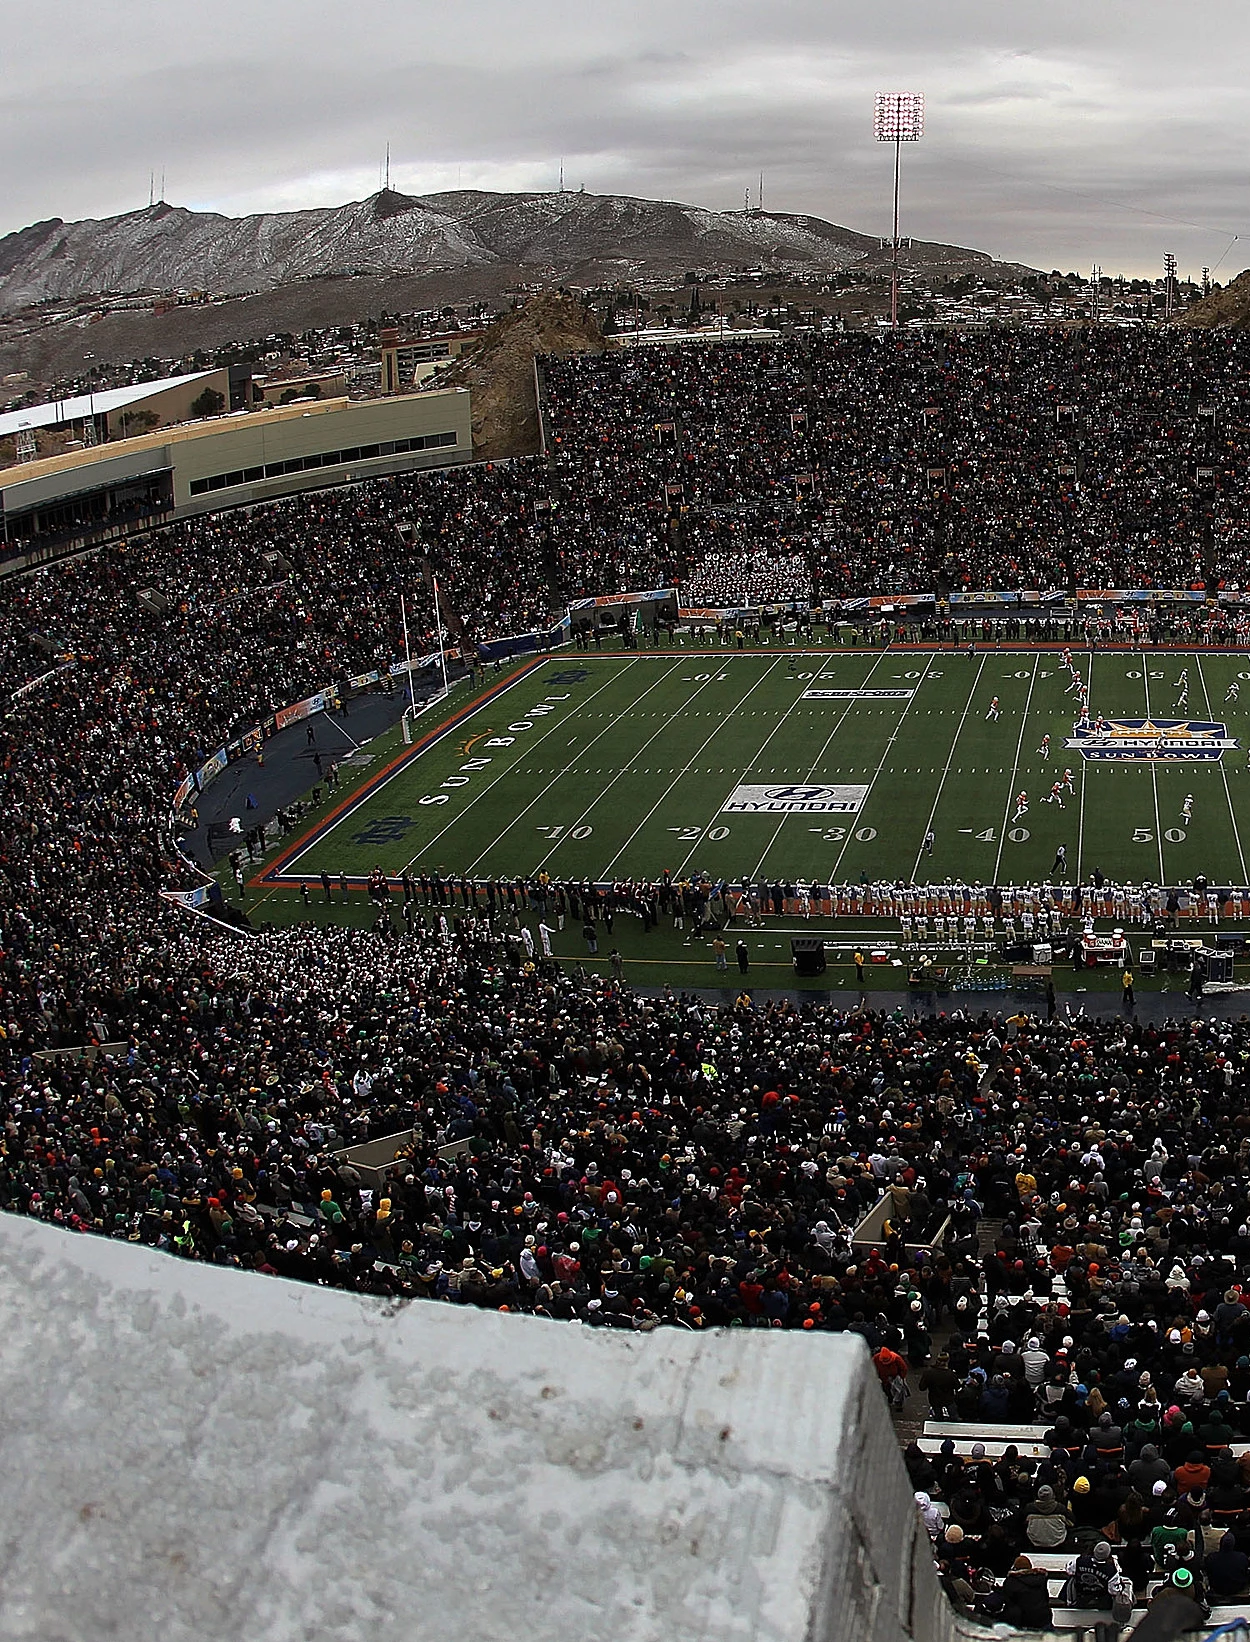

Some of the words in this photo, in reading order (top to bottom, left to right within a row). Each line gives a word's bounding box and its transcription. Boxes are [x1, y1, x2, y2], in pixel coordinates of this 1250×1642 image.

[418, 757, 493, 806] SUN
[483, 692, 572, 748] BOWL
[727, 801, 858, 811] HYUNDAI
[548, 825, 594, 841] 10
[676, 825, 733, 842] 20
[820, 825, 878, 842] 30
[974, 827, 1032, 843] 40
[1131, 828, 1187, 843] 50
